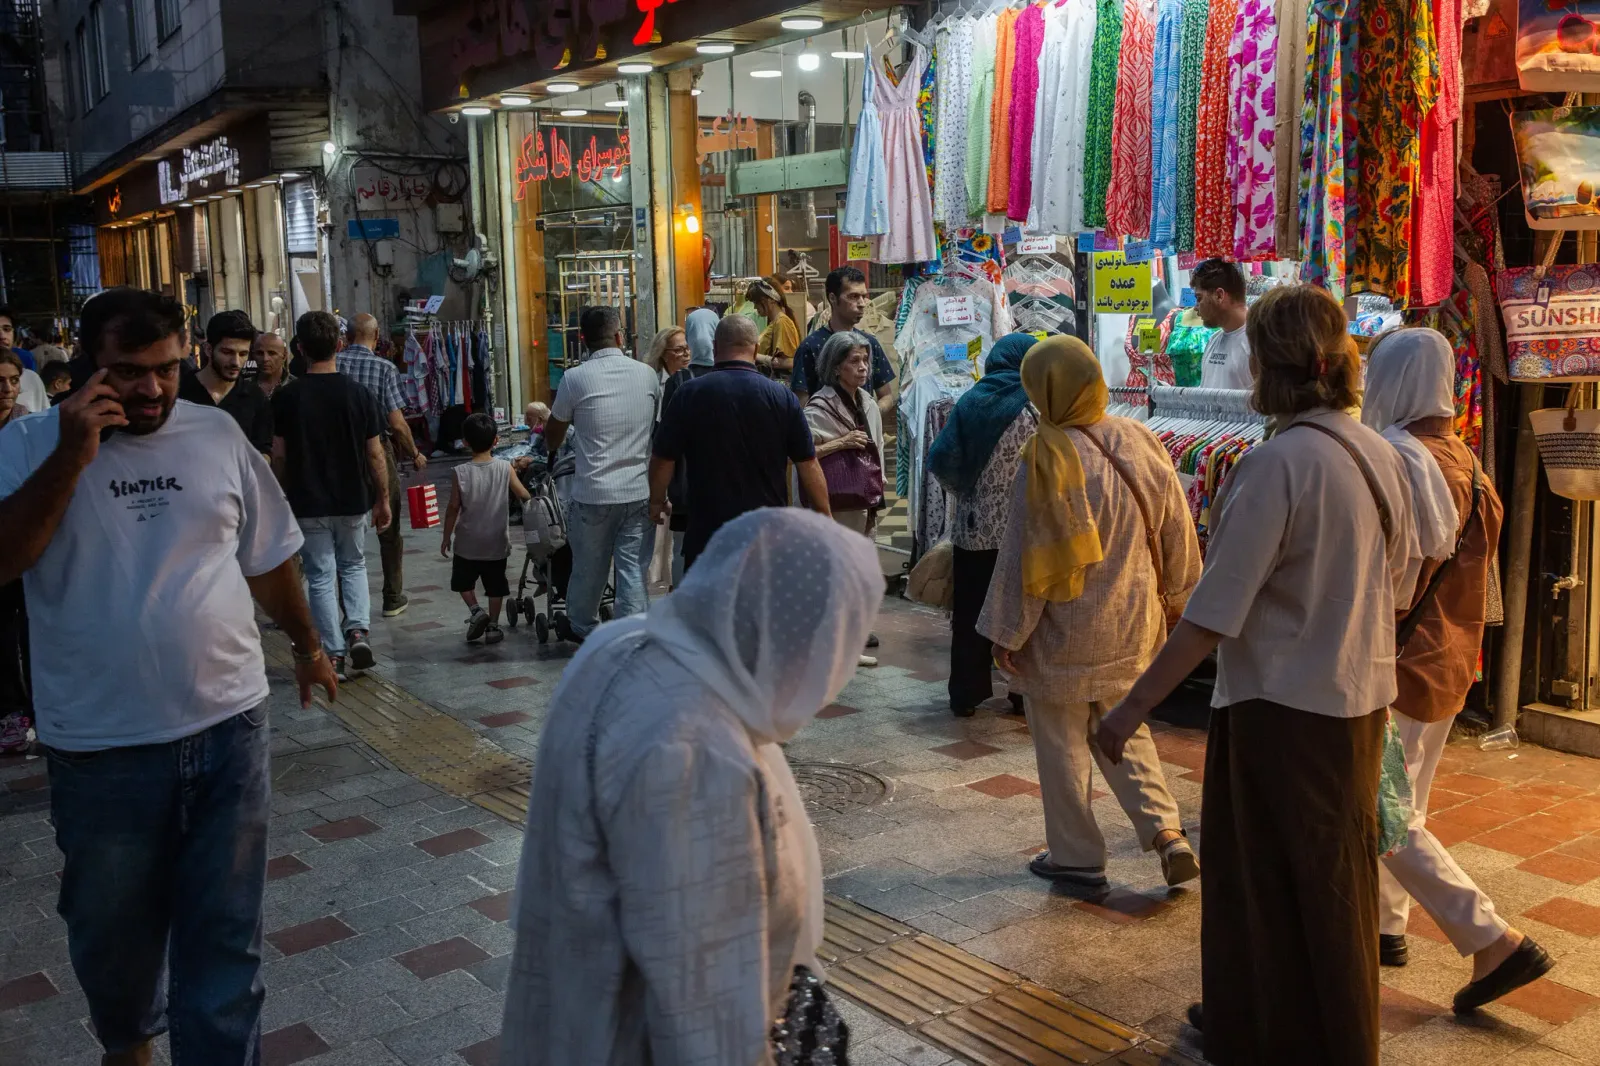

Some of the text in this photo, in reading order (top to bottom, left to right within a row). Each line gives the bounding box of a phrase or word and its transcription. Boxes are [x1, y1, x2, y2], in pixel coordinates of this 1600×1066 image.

[391, 176, 425, 201] بازار
[852, 243, 868, 251] حراج
[1096, 254, 1122, 270] تولیدی
[1110, 277, 1136, 289] عمده
[1126, 299, 1149, 311] موجود
[109, 475, 183, 498] SENTIER
